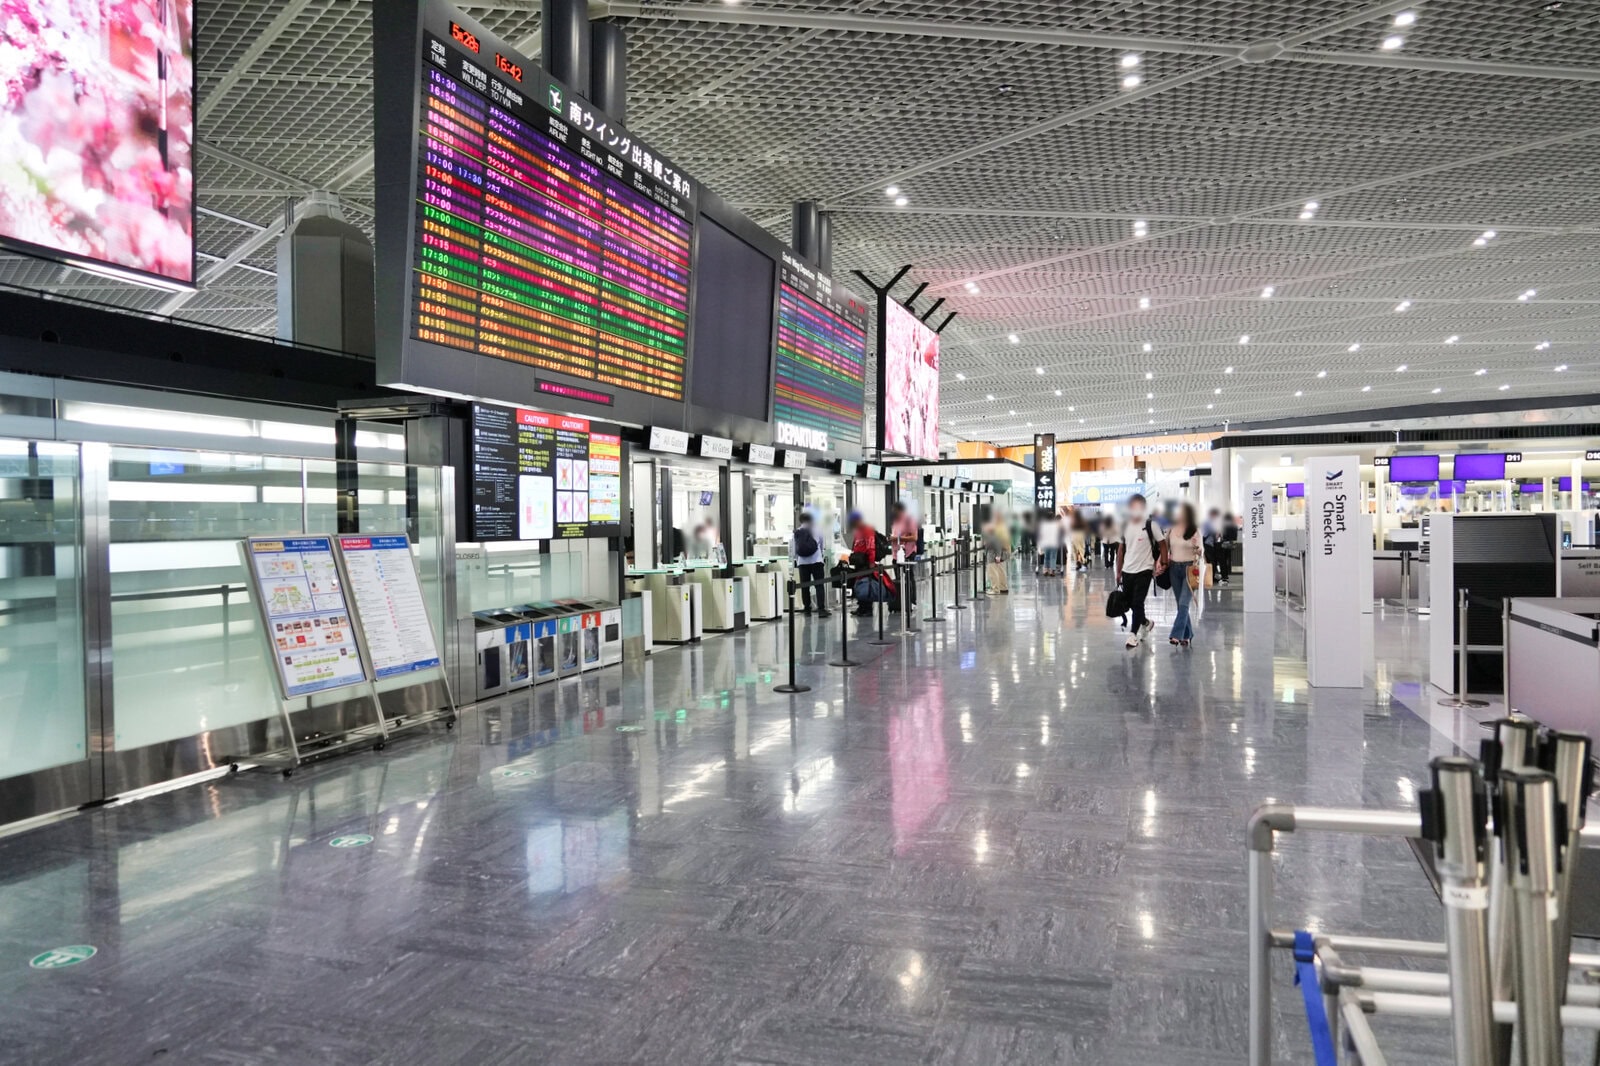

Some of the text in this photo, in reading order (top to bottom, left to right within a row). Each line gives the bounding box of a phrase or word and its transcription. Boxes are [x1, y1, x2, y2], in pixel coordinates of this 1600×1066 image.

[430, 52, 446, 67] TIME
[496, 54, 522, 82] 16:42
[431, 70, 455, 91] 16:30
[462, 72, 473, 84] WILL
[430, 84, 455, 104] 16:50
[430, 97, 454, 117] 16:50
[548, 127, 566, 143] AIRLINE
[427, 138, 453, 157] 16:55
[570, 101, 690, 198] 南ウイング出発便ご案内
[581, 147, 595, 160] FLIGHT
[427, 152, 452, 170] 17:00
[426, 166, 452, 184] 17:00
[426, 179, 451, 197] 17:00
[425, 193, 450, 210] 17:00
[424, 207, 450, 223] 17:00
[424, 220, 449, 236] 17:10
[423, 234, 448, 250] 17:15
[422, 248, 448, 263] 17:30
[422, 262, 447, 276] 17:30
[421, 275, 447, 289] 17:50
[421, 289, 446, 302] 17:55
[420, 302, 446, 316] 18:00
[419, 316, 445, 328] 18:15
[419, 329, 444, 342] 18:15
[778, 421, 828, 451] DEPARTURES
[1323, 494, 1347, 555] Smart Check-in
